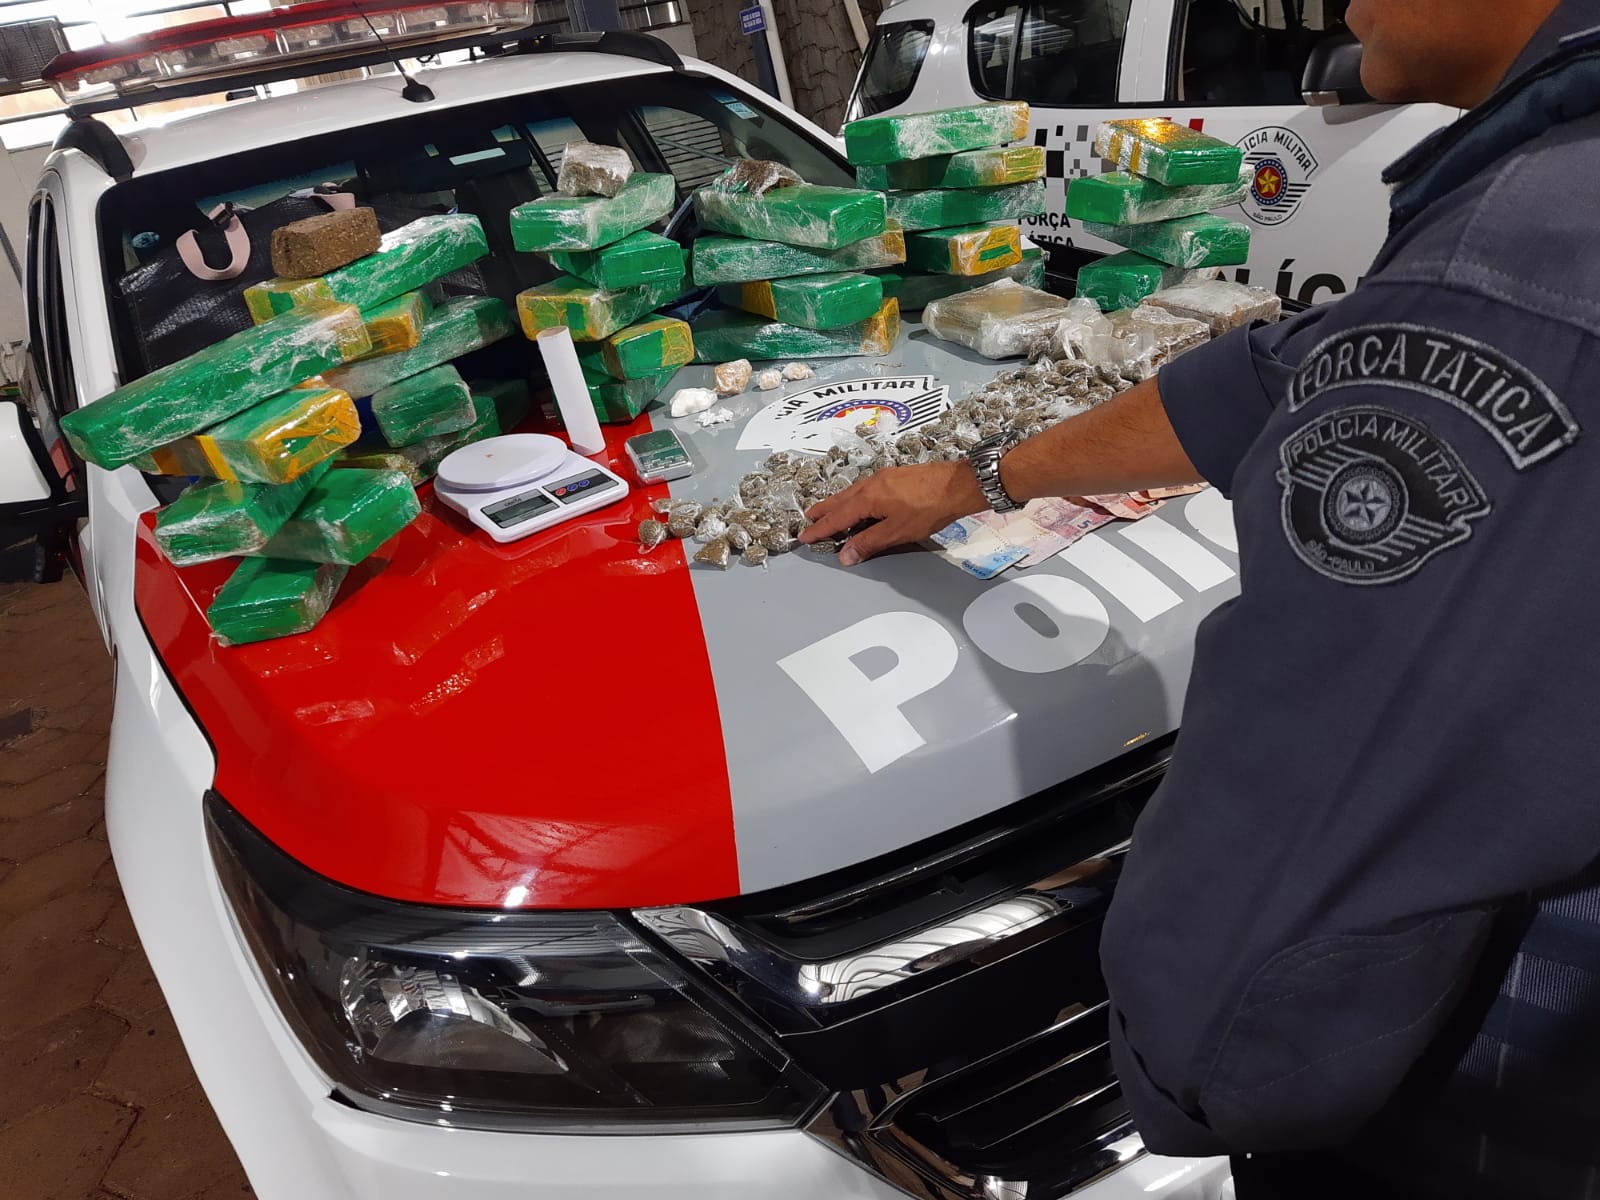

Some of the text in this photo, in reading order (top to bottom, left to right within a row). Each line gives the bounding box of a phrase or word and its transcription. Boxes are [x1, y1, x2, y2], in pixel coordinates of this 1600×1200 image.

[1243, 130, 1311, 171] ICIA MILITAR
[813, 380, 915, 399] MILITAR
[1300, 333, 1406, 399] FORÇA
[1382, 421, 1469, 509] MILITAR
